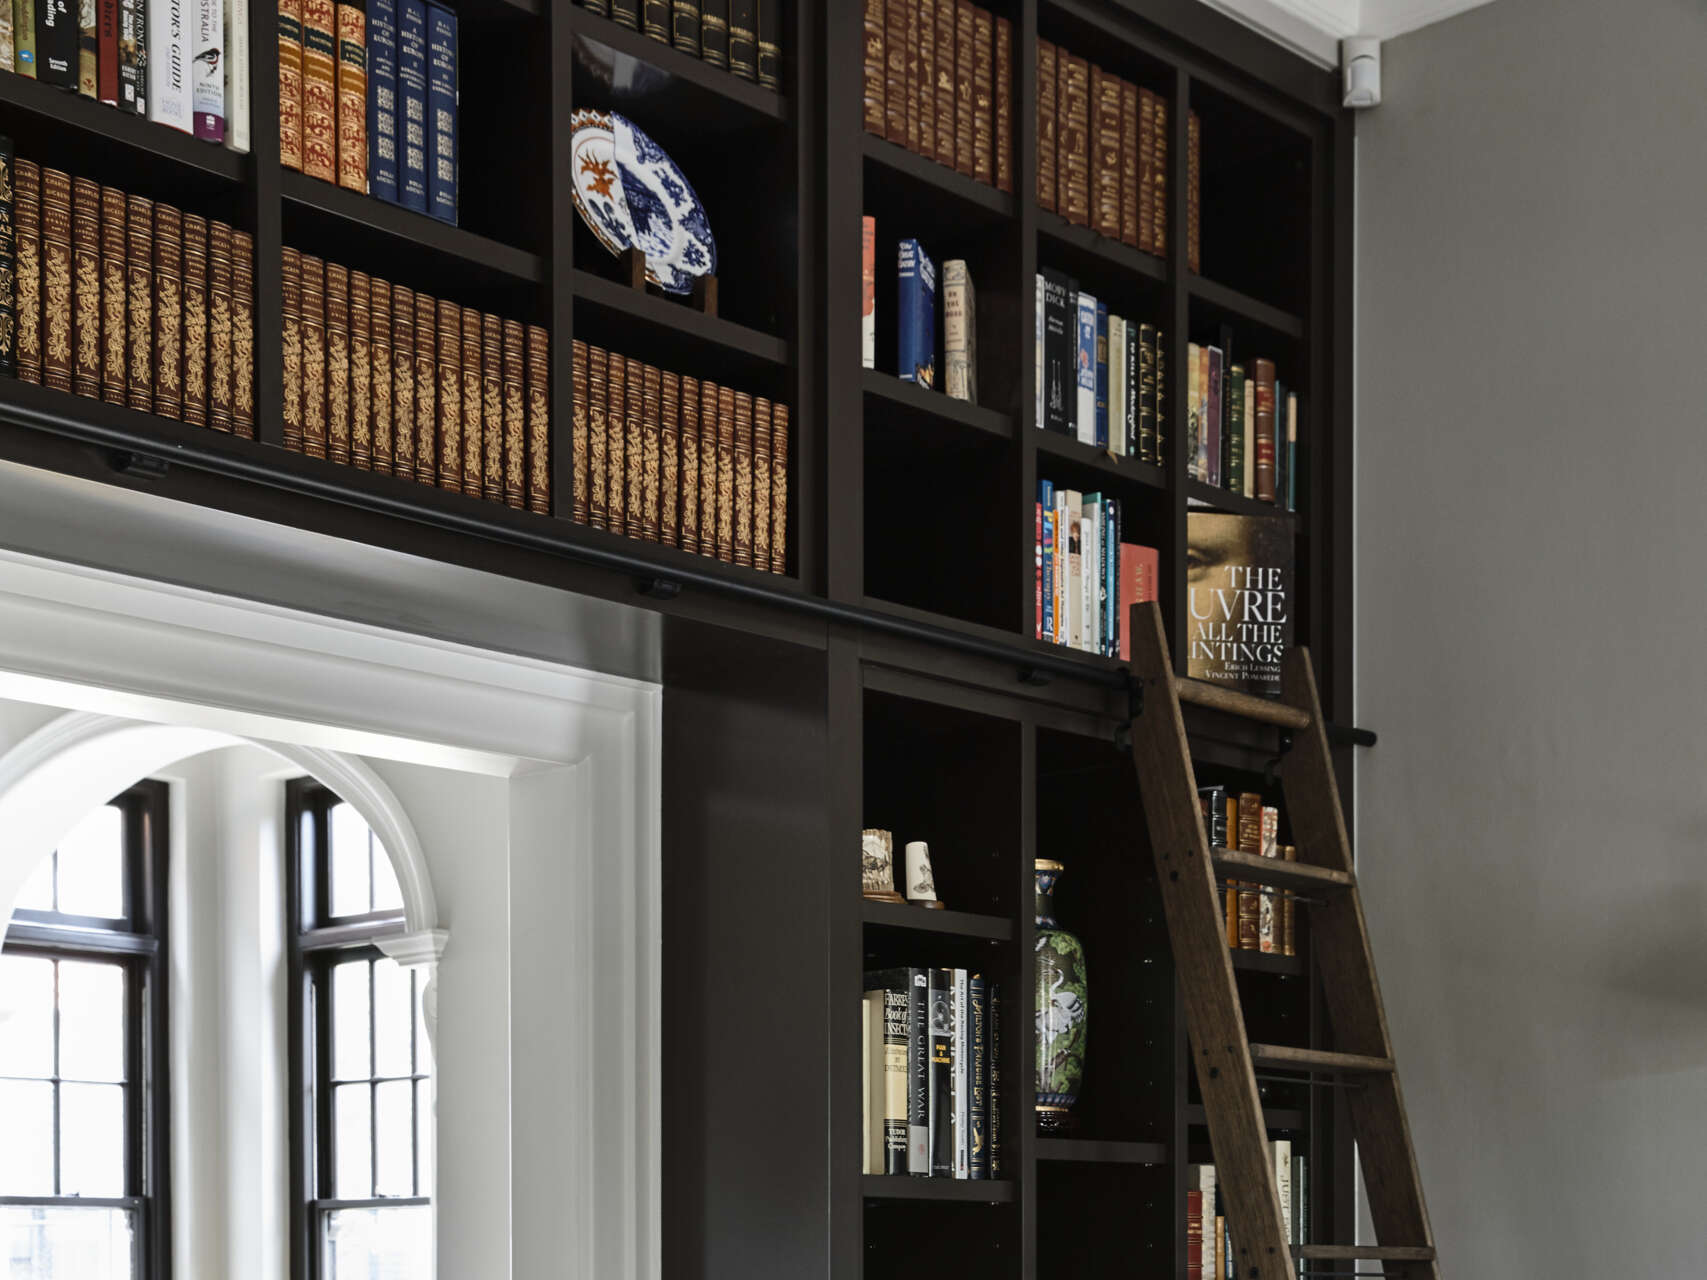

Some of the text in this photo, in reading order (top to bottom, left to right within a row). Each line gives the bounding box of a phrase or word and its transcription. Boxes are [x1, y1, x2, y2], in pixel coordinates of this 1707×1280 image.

[57, 1, 67, 13] of
[135, 12, 145, 47] FRONT
[171, 44, 182, 92] GUIDE
[1045, 281, 1066, 296] MOBY
[1046, 292, 1065, 308] DICK
[1043, 510, 1053, 600] PLAY Therapy
[1224, 566, 1282, 590] THE
[1190, 587, 1287, 624] UVRE
[1195, 622, 1282, 643] ALL THE
[1192, 641, 1284, 663] INTINGS
[885, 1007, 902, 1020] Book
[917, 1001, 925, 1119] THE GREAT WAR
[973, 1045, 984, 1085] PARADISE
